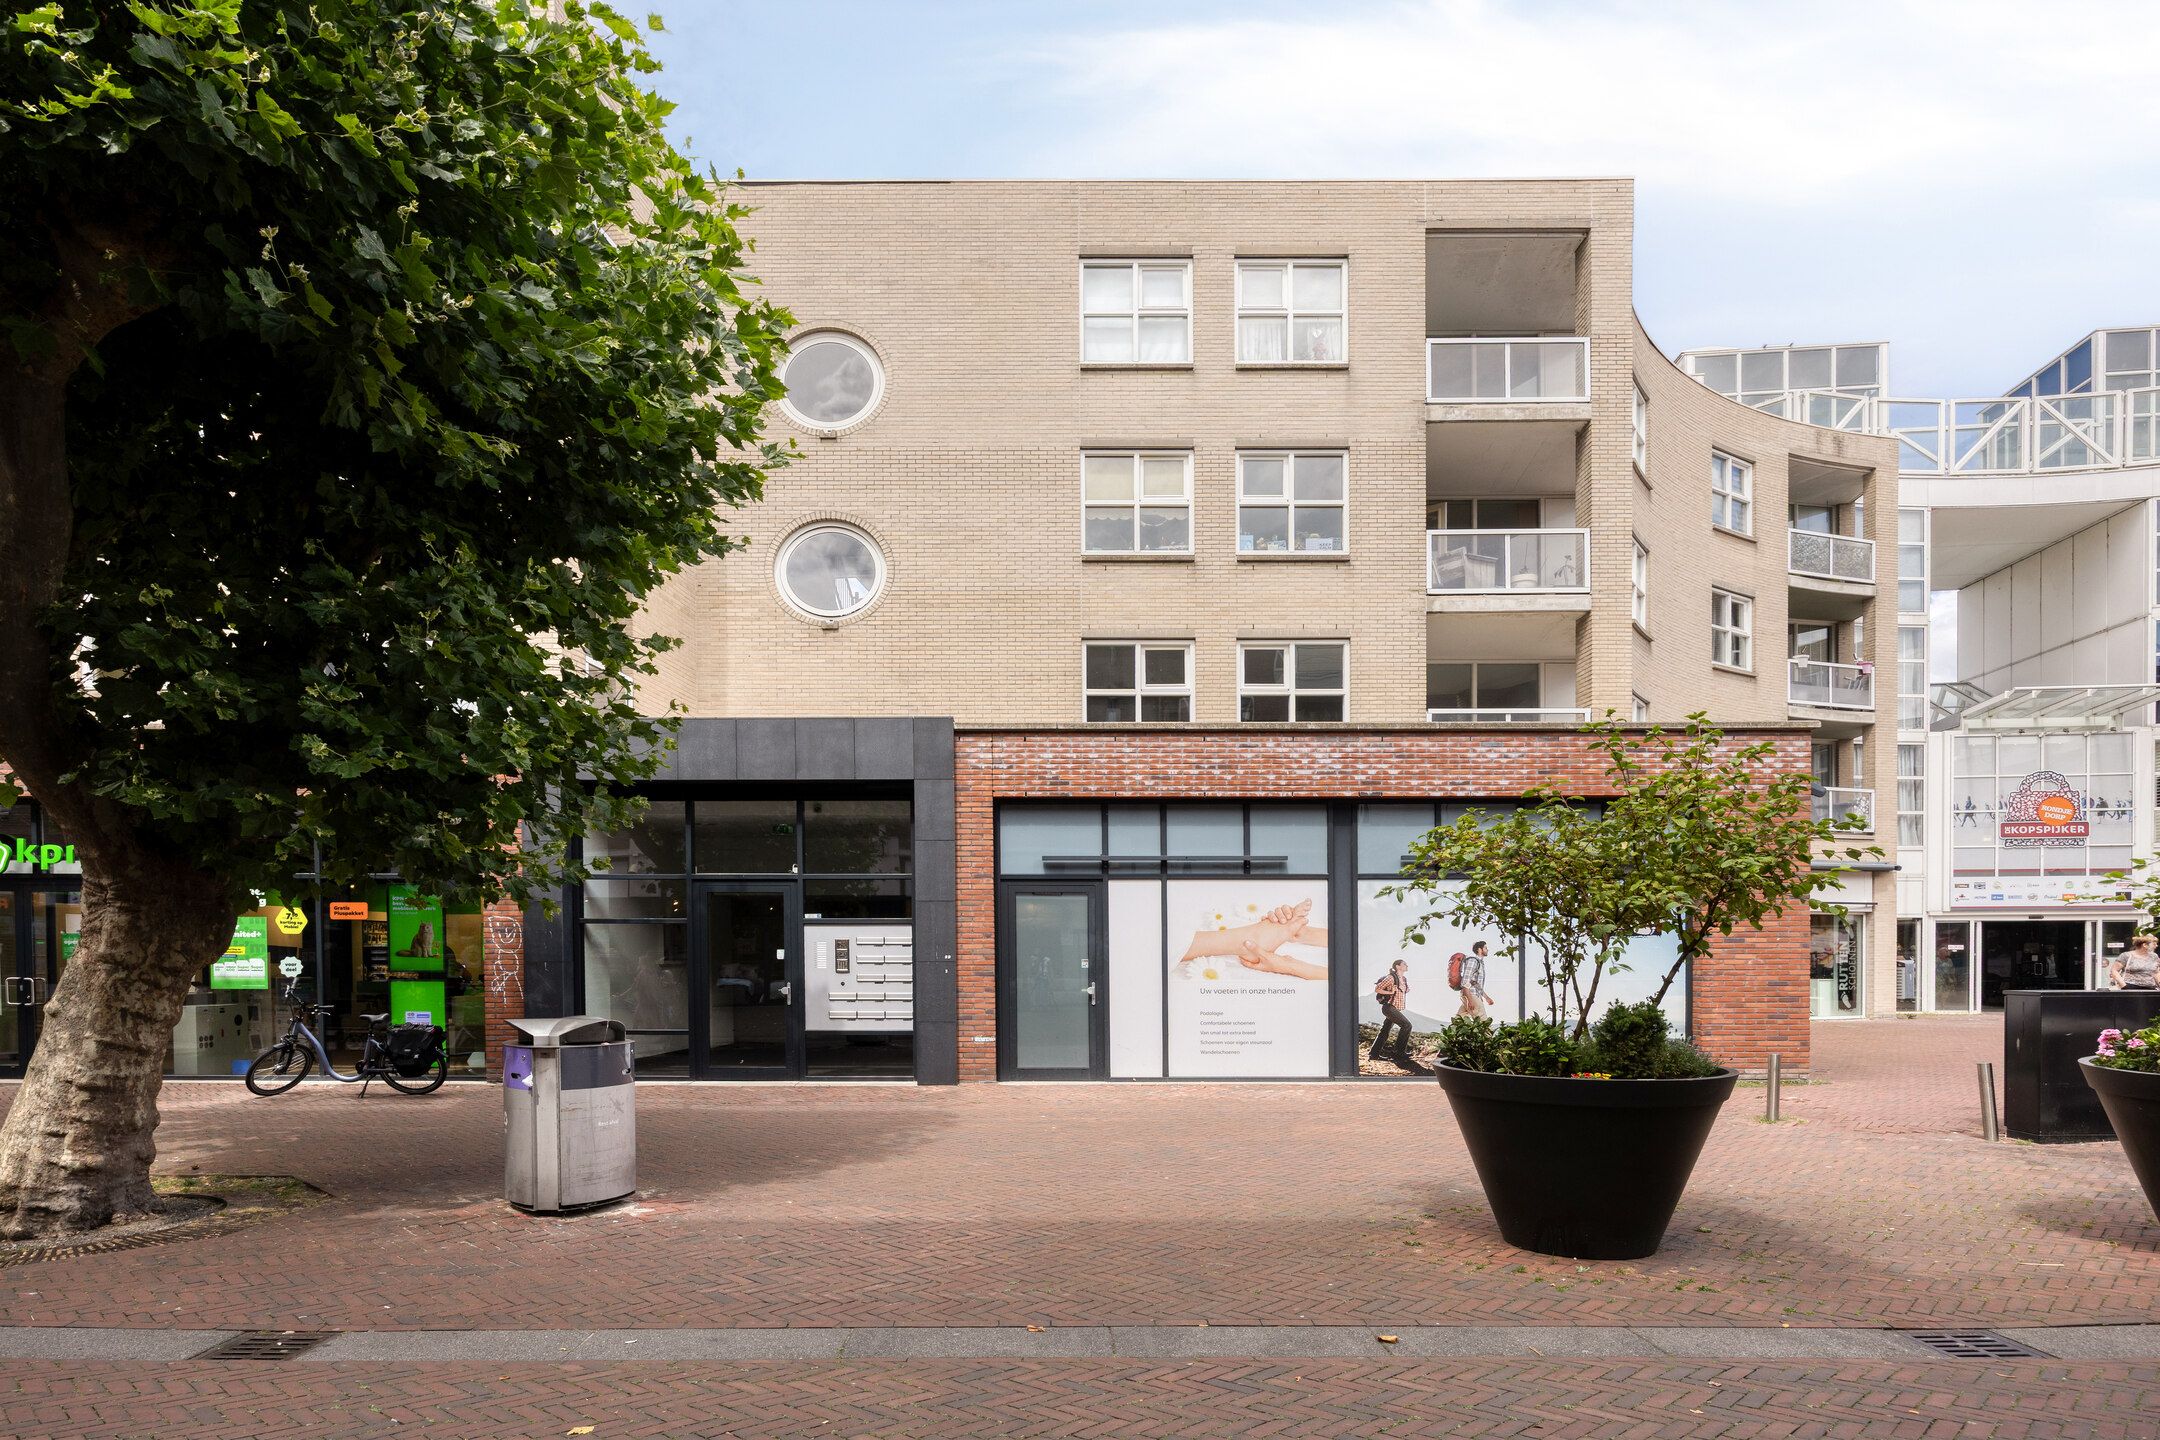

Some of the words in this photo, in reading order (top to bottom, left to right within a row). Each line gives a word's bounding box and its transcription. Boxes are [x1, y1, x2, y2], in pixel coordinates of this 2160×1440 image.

[2041, 805, 2072, 815] RONDJE
[2044, 812, 2066, 820] DORP
[2004, 826, 2010, 834] DE
[2011, 825, 2085, 834] KOPSPIJKER
[1838, 941, 1849, 991] RUTTEN
[1267, 987, 1296, 995] handen
